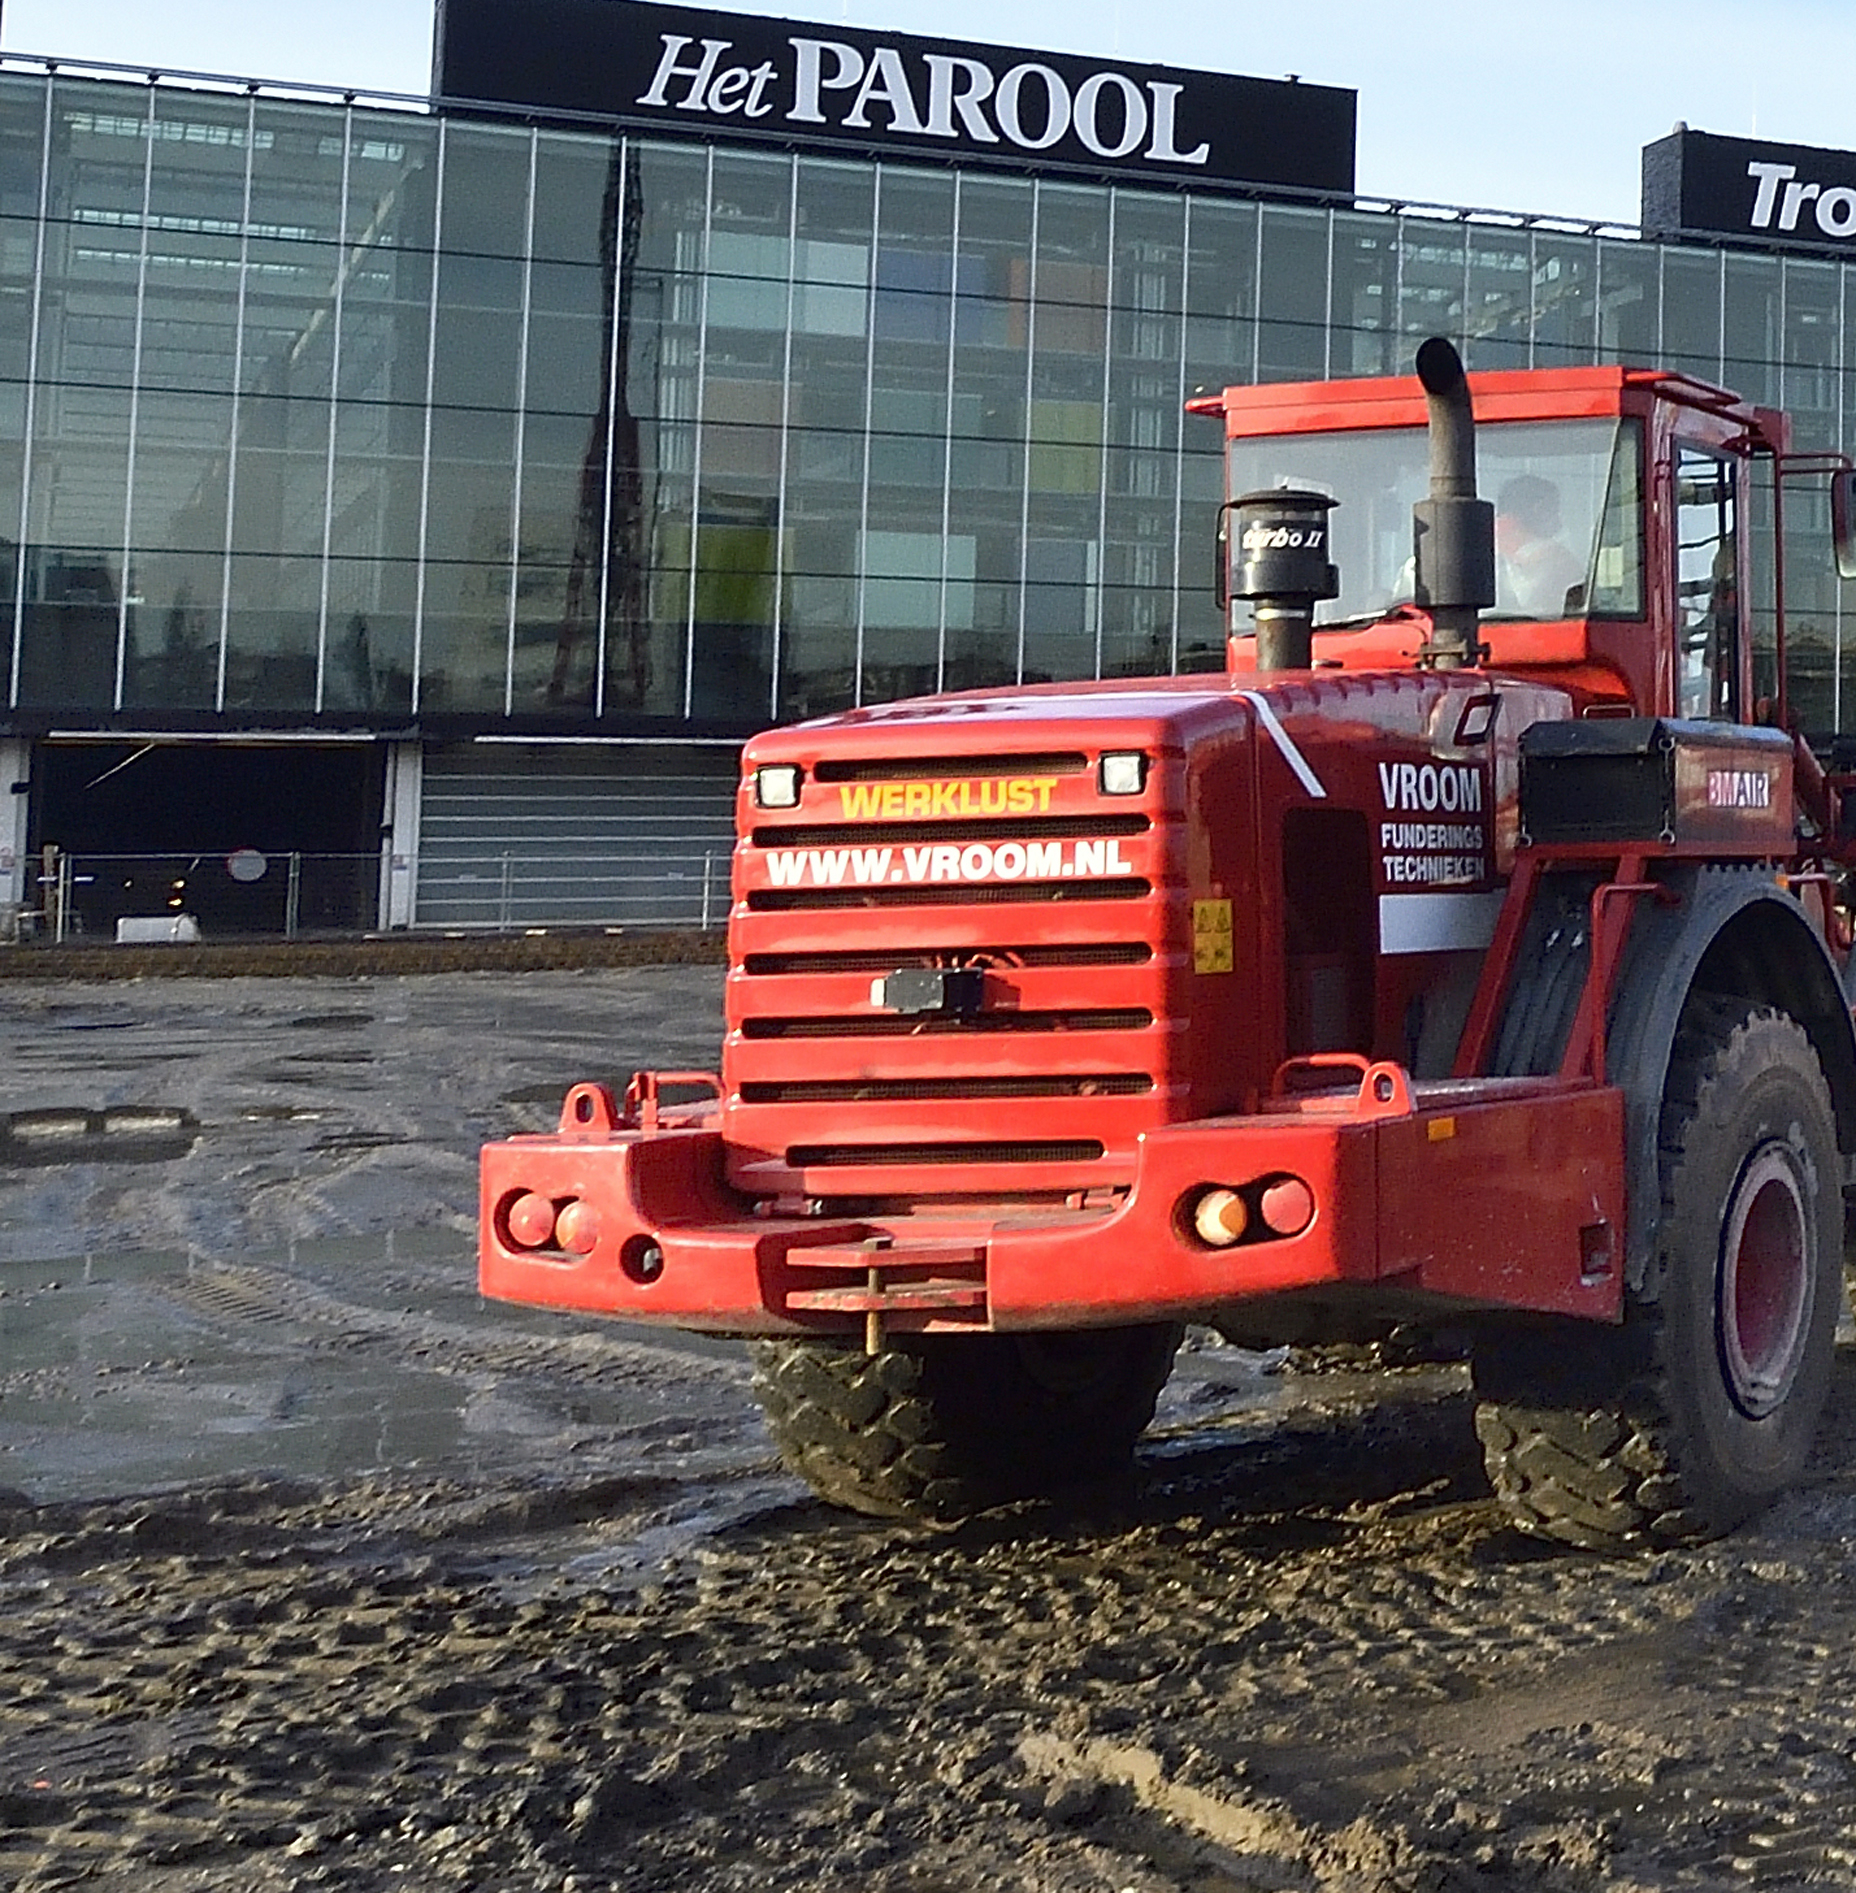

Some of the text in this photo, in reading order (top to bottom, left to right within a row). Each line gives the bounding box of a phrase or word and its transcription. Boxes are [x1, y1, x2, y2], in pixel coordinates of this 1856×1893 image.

[636, 33, 1210, 165] Het PAROOL
[840, 778, 1058, 819] WERKLUST
[1378, 761, 1481, 812] VROOM
[1381, 822, 1483, 849] FUNDERINGS
[766, 840, 1132, 887] WWW.VROOM.NL
[1382, 854, 1485, 882] TECHNIEKEN
